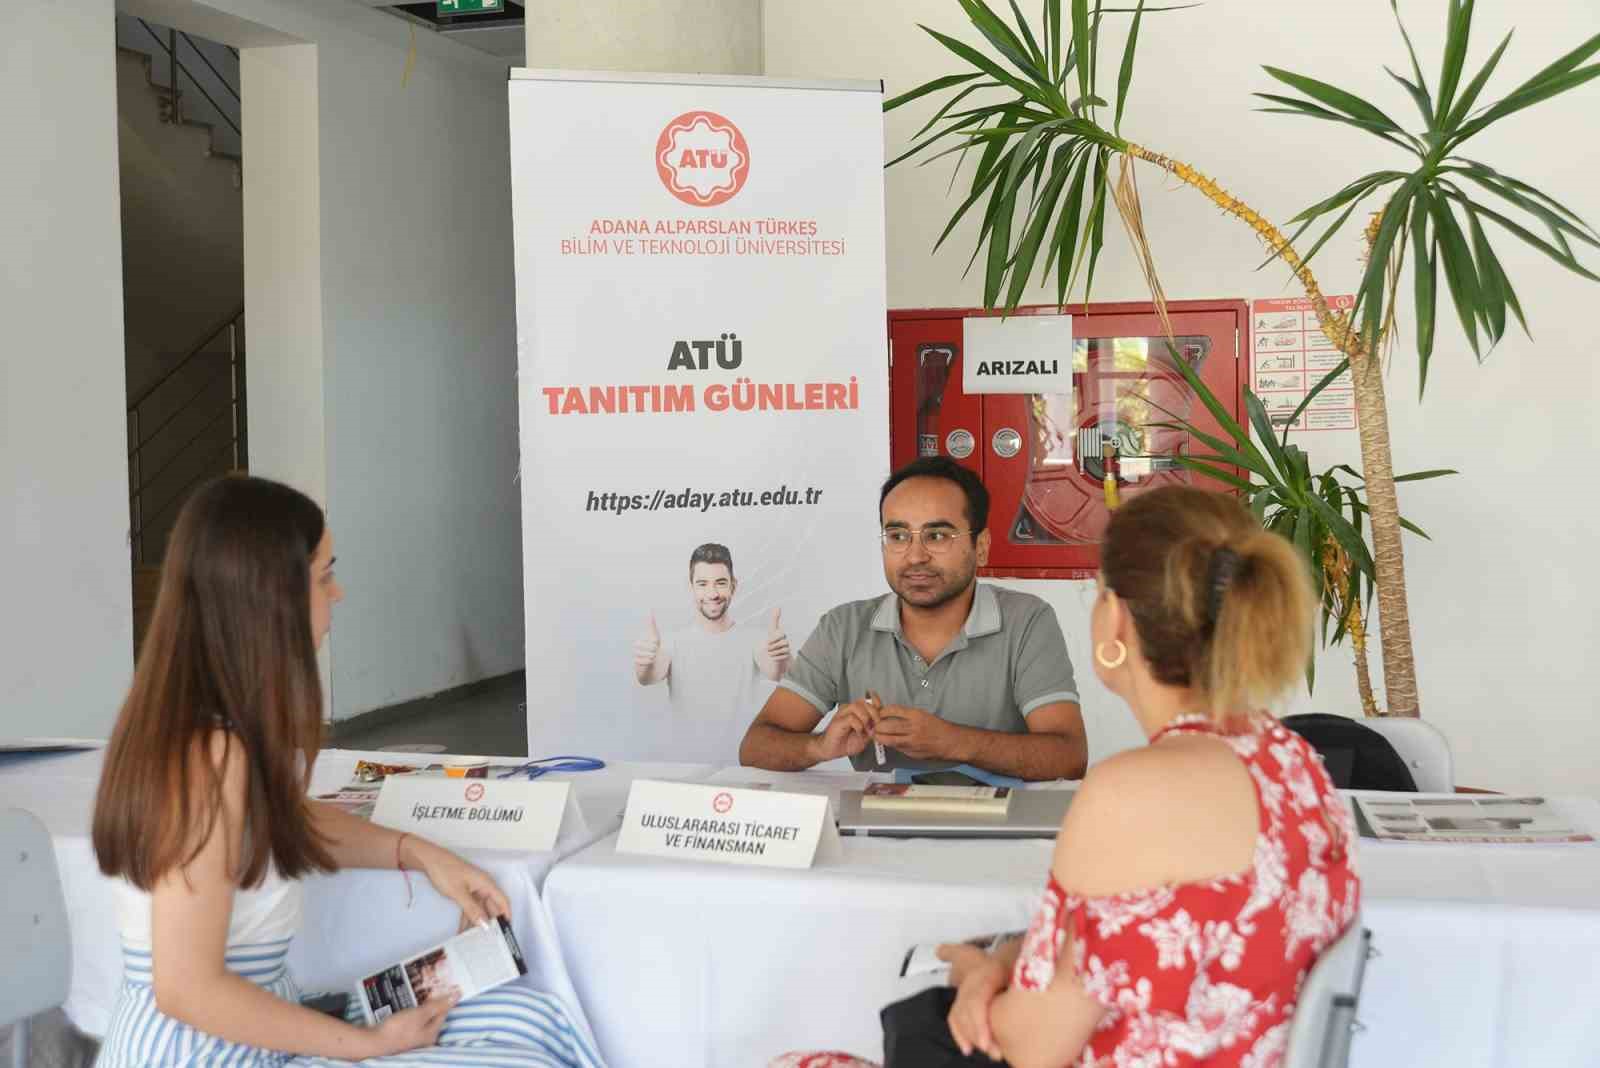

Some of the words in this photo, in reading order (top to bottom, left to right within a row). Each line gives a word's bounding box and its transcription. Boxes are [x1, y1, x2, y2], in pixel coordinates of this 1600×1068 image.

[679, 149, 728, 169] ATÜ
[589, 219, 650, 235] ADANA
[655, 219, 751, 235] ALPARSLAN
[756, 217, 817, 238] TÜRKEŞ
[560, 236, 609, 255] BİLİM
[612, 239, 633, 255] VE
[640, 238, 731, 256] TEKNOLOJİ
[735, 237, 846, 256] ÜNİVERSİTESİ
[667, 333, 743, 371] ATÜ
[976, 359, 1058, 376] ARIZALI
[542, 384, 696, 415] TANITIM
[703, 376, 859, 411] GÜNLERİ
[586, 486, 823, 515] https://aday.atu.edu.tr
[411, 804, 466, 821] İŞLETME
[641, 814, 740, 835] ULUSLARARASI
[744, 821, 799, 841] TİCARET
[665, 835, 683, 848] VE
[685, 834, 765, 854] FİNANSMAN
